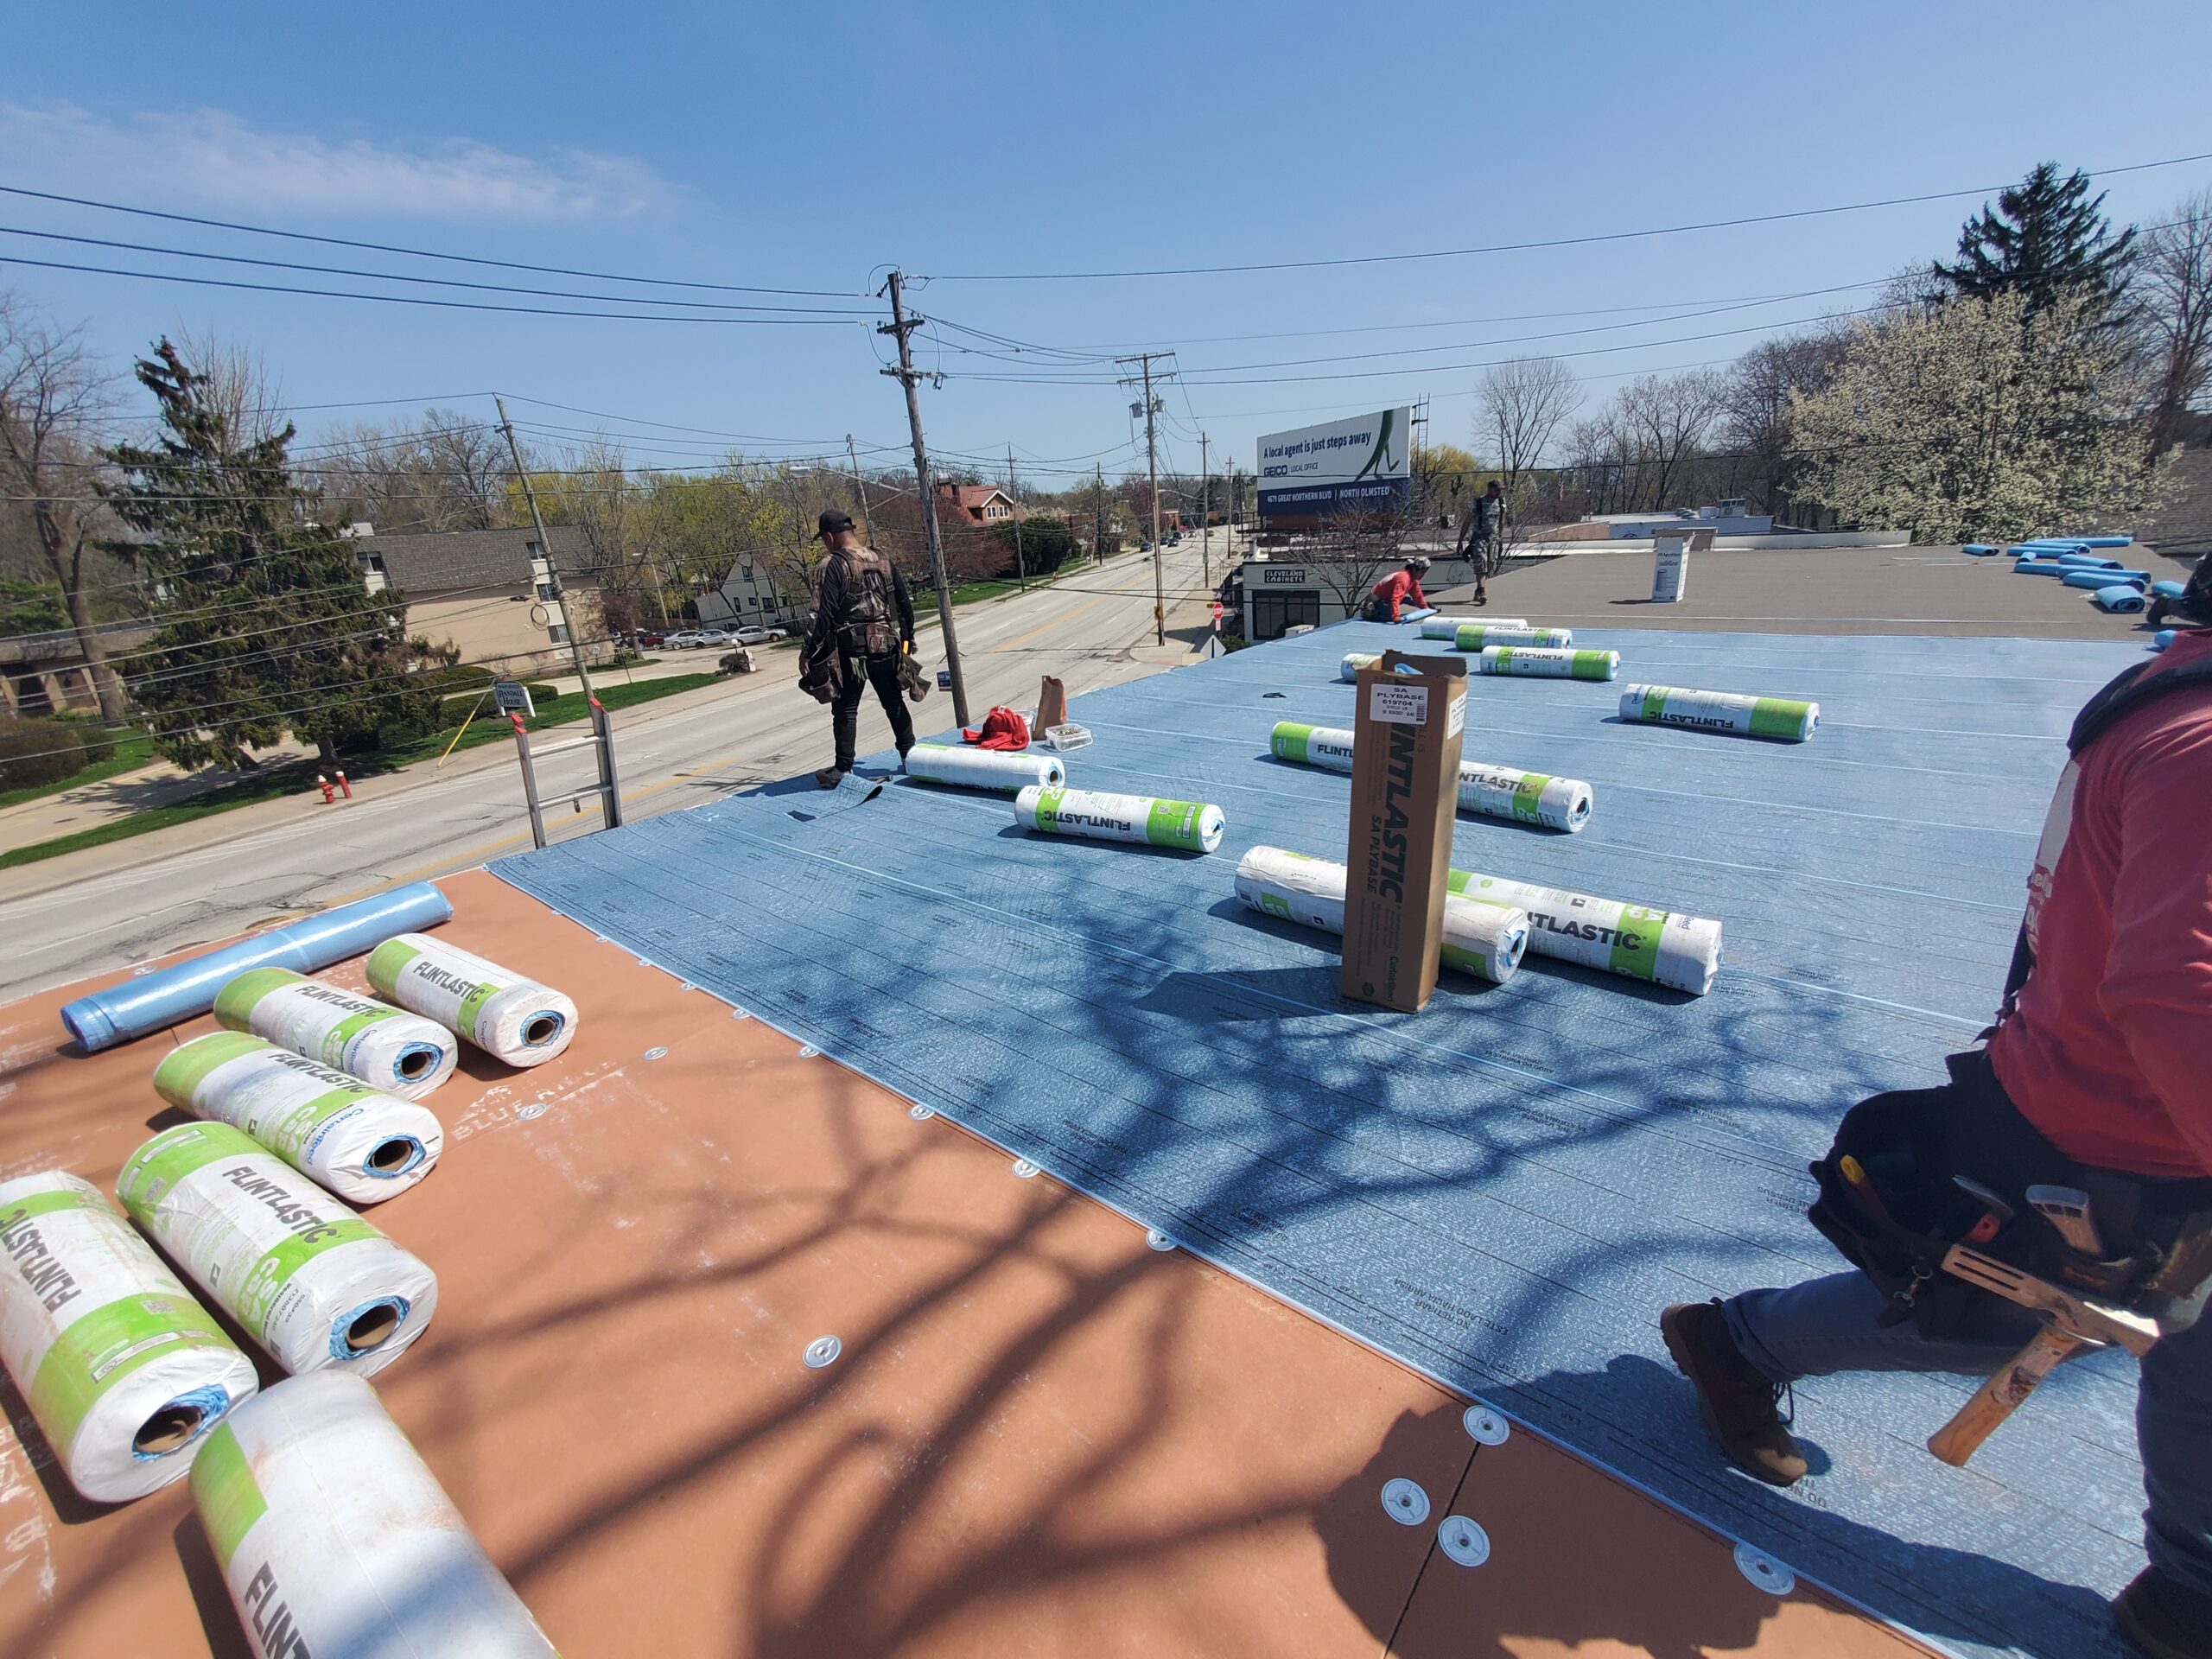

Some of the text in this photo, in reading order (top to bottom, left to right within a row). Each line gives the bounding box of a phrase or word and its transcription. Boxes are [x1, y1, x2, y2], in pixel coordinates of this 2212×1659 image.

[1264, 432, 1371, 459] A local agent is just steps away
[1264, 465, 1287, 477] GEICO
[1291, 462, 1319, 473] LOCAL OFFICE
[1292, 493, 1319, 501] NORTHERN
[1319, 491, 1332, 499] BLVD
[1340, 488, 1359, 499] NORTH
[1360, 486, 1389, 497] OLMSTED
[1649, 711, 1734, 728] FLINTLASTIC
[1318, 744, 1354, 758] FLINTL
[1044, 810, 1131, 832] FLINTLASTIC
[1367, 836, 1380, 893] PLYBASE
[412, 961, 486, 1003] FLINTLASTIC
[295, 985, 389, 1020] FLINTLASTIC
[266, 1052, 368, 1094] FLINTLASTIC
[306, 1108, 364, 1164] CertainTeed
[222, 1166, 337, 1243] FLINTLASTIC
